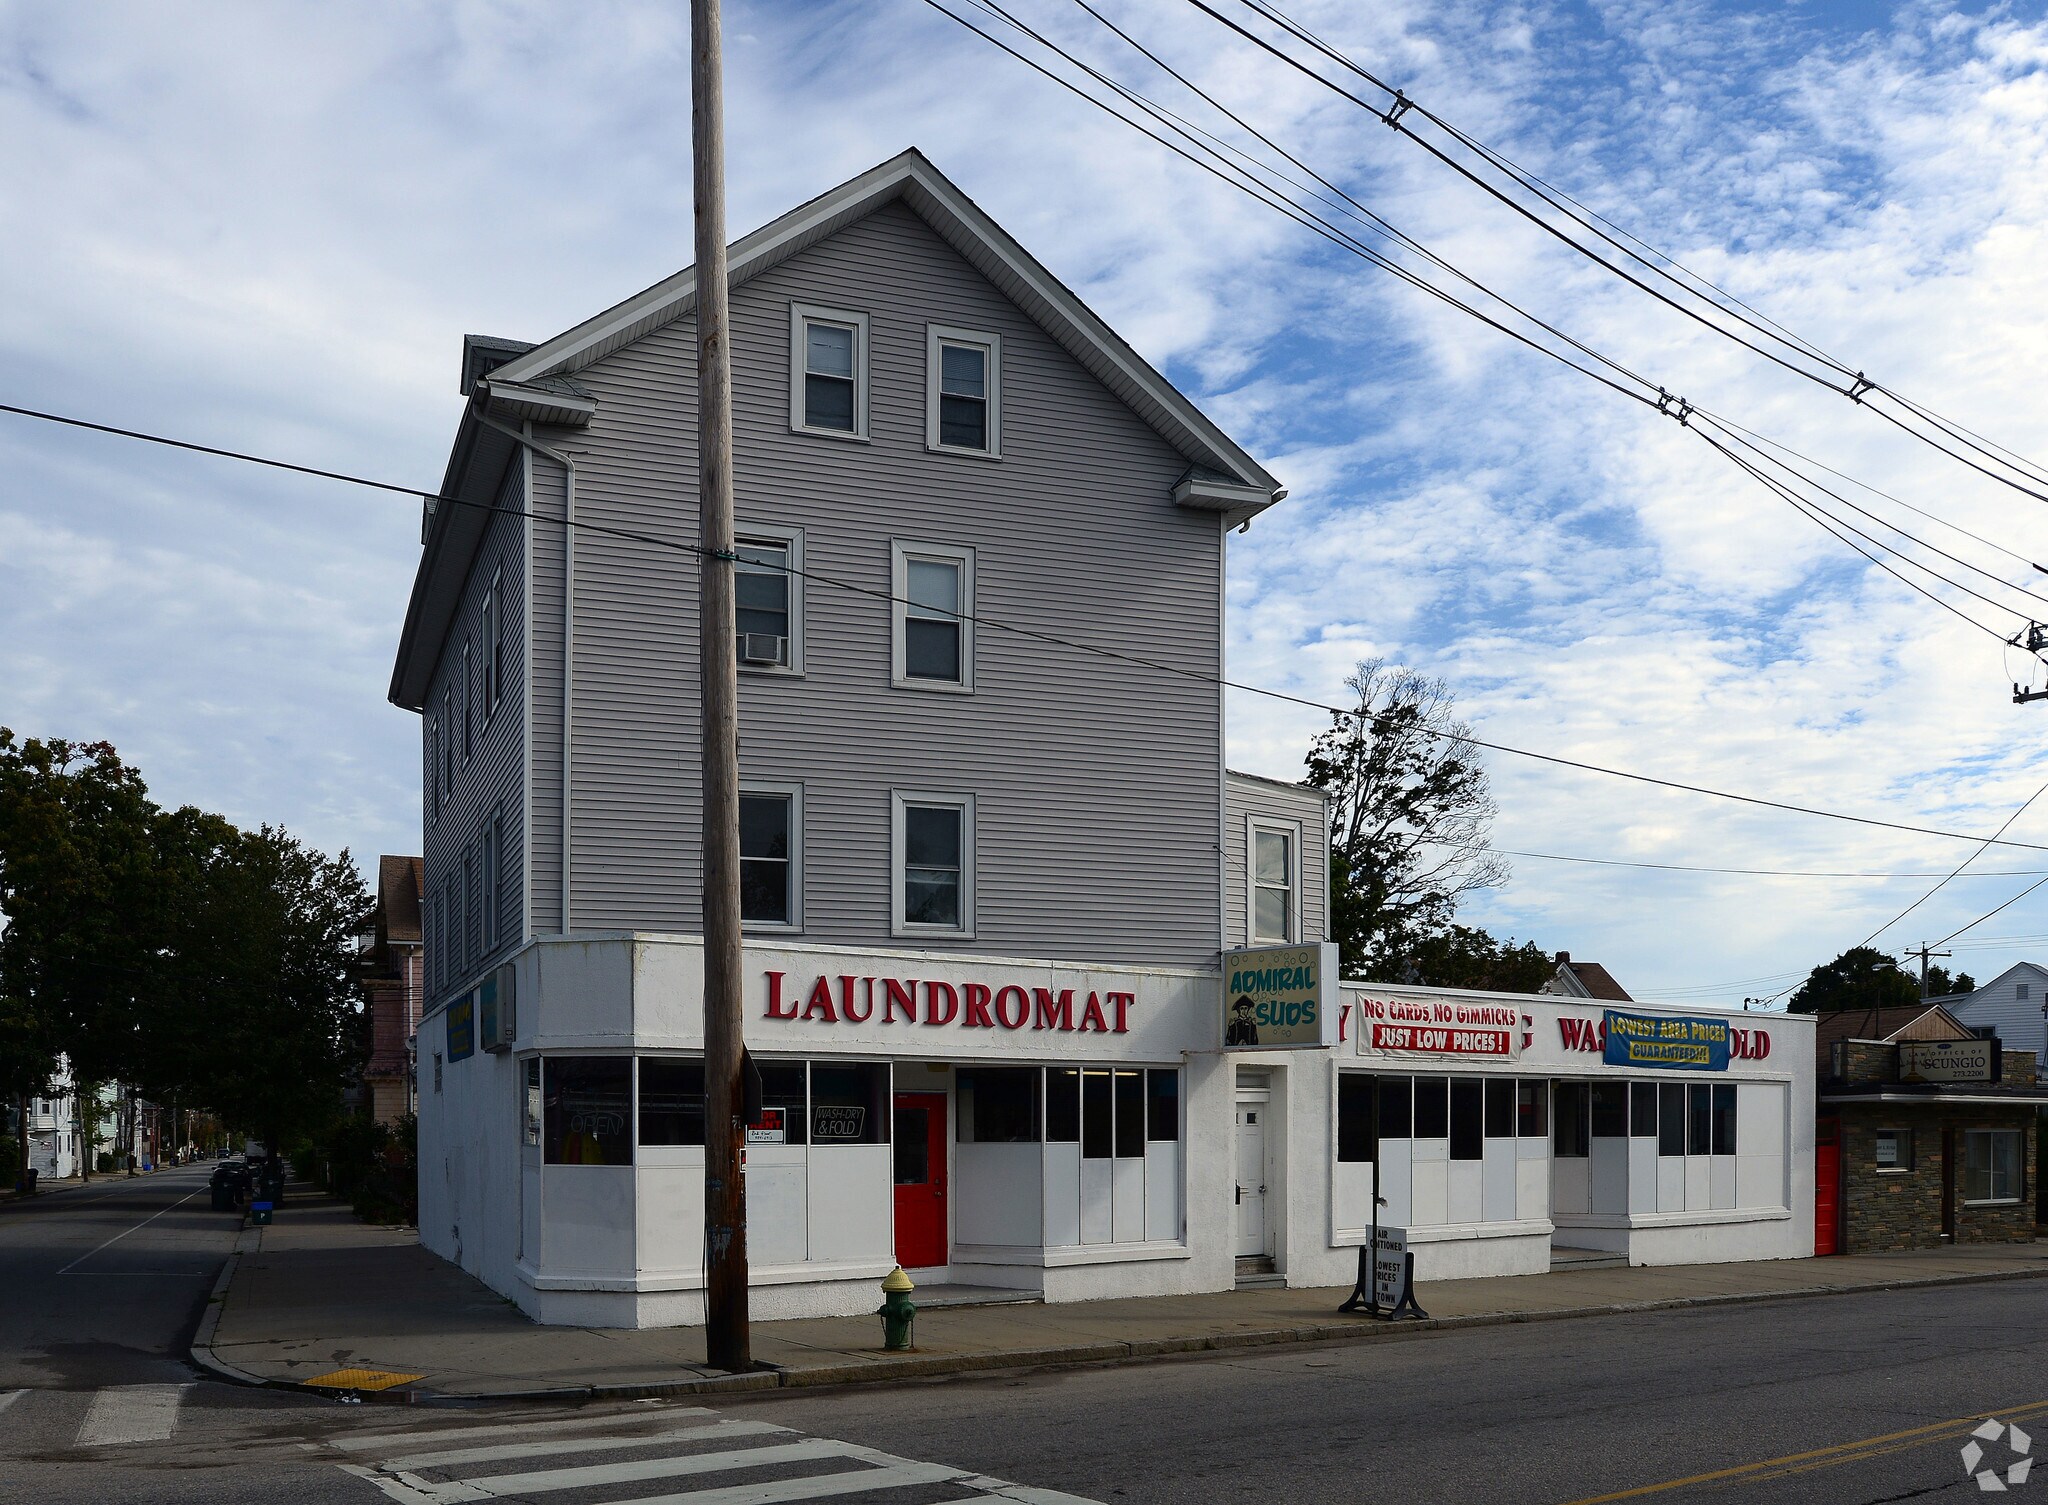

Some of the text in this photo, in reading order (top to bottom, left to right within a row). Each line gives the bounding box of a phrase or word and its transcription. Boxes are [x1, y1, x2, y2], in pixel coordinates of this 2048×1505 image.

[1230, 966, 1316, 994] ADMIRAL
[764, 971, 1135, 1033] LAUNDROMAT
[1364, 998, 1385, 1018] NO
[1389, 1000, 1433, 1024] CARDS,
[1434, 1004, 1453, 1023] NO
[1256, 1000, 1316, 1027] SUDS
[1379, 1027, 1412, 1048] JUST
[1416, 1029, 1449, 1049] LOW
[1558, 1017, 1606, 1052] WAS
[1729, 1027, 1771, 1060] OLD
[1610, 1016, 1726, 1042] LOWEST AREA PRICES
[1633, 1043, 1707, 1061] GUARANTEED!!!
[1924, 1057, 1986, 1070] SCUNGIO
[818, 1108, 862, 1119] WASH-DRY
[571, 1114, 620, 1135] OPEN
[818, 1120, 856, 1134] & FOLD
[1377, 1229, 1388, 1239] AIR
[1375, 1261, 1400, 1272] OWEST
[1376, 1272, 1396, 1282] RICES
[1377, 1293, 1395, 1303] TOWN
